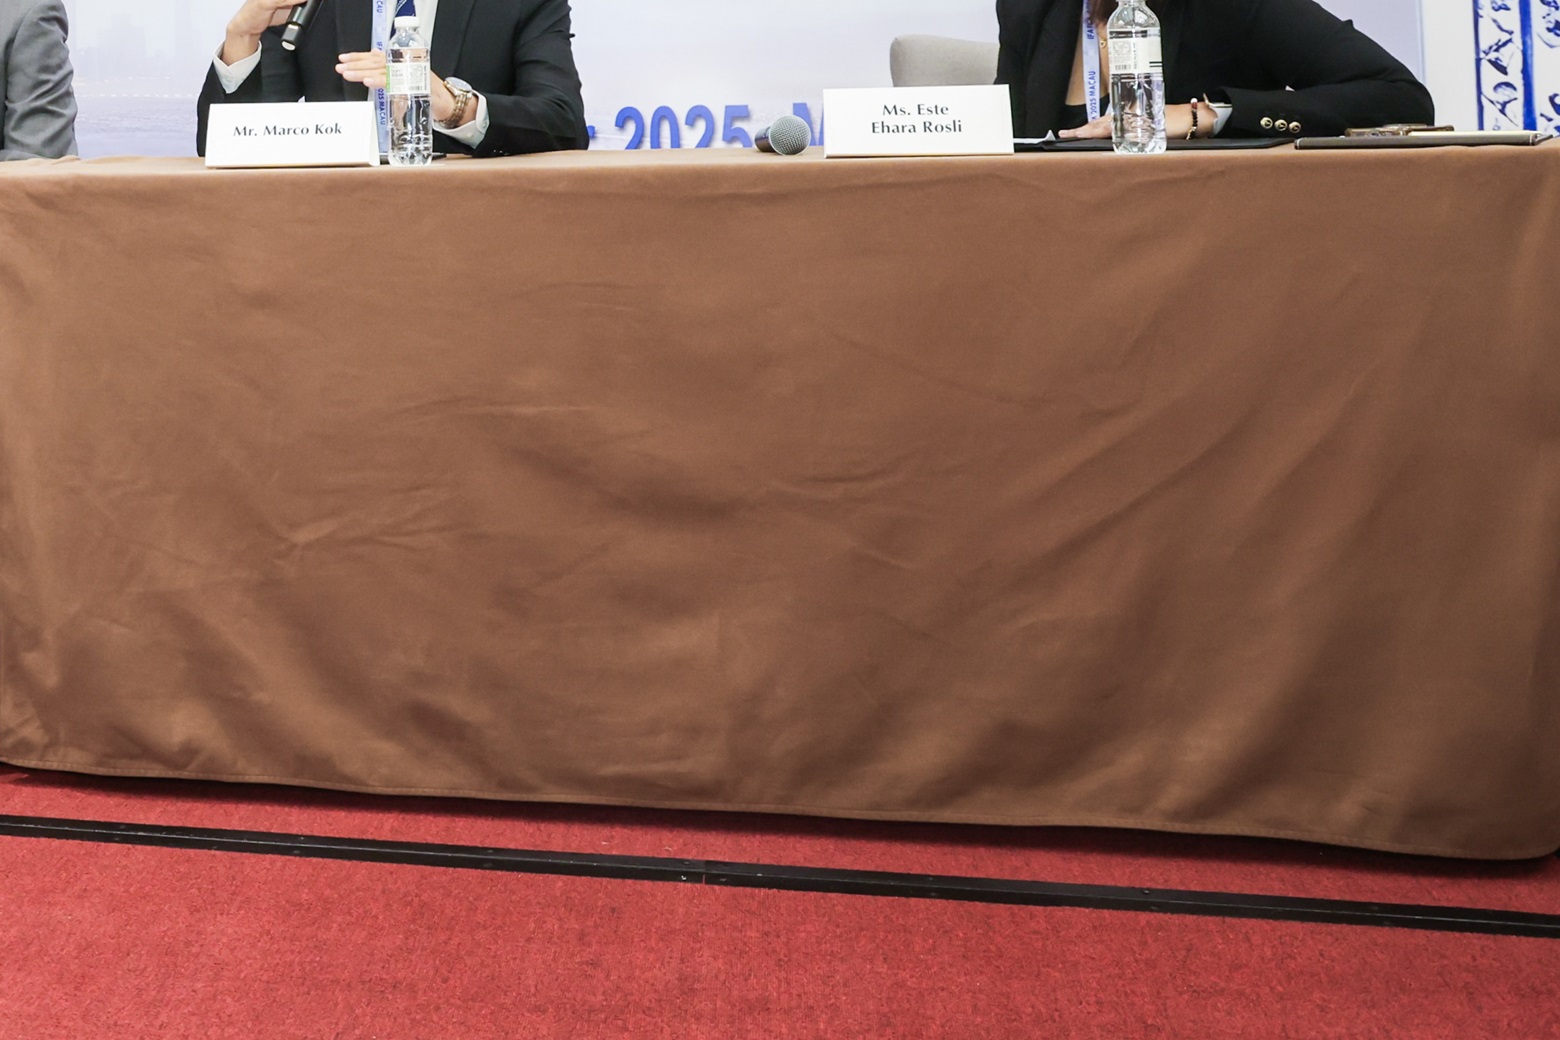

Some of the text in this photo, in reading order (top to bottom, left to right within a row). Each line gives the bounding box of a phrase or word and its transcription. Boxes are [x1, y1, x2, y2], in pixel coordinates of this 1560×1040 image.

[1088, 70, 1096, 97] MACAU
[378, 100, 386, 125] MACAU
[882, 103, 949, 116] Ms. Este
[233, 122, 343, 137] Mr. Marco Kok
[614, 104, 753, 150] 2025
[871, 119, 963, 134] Ehara Rosli
